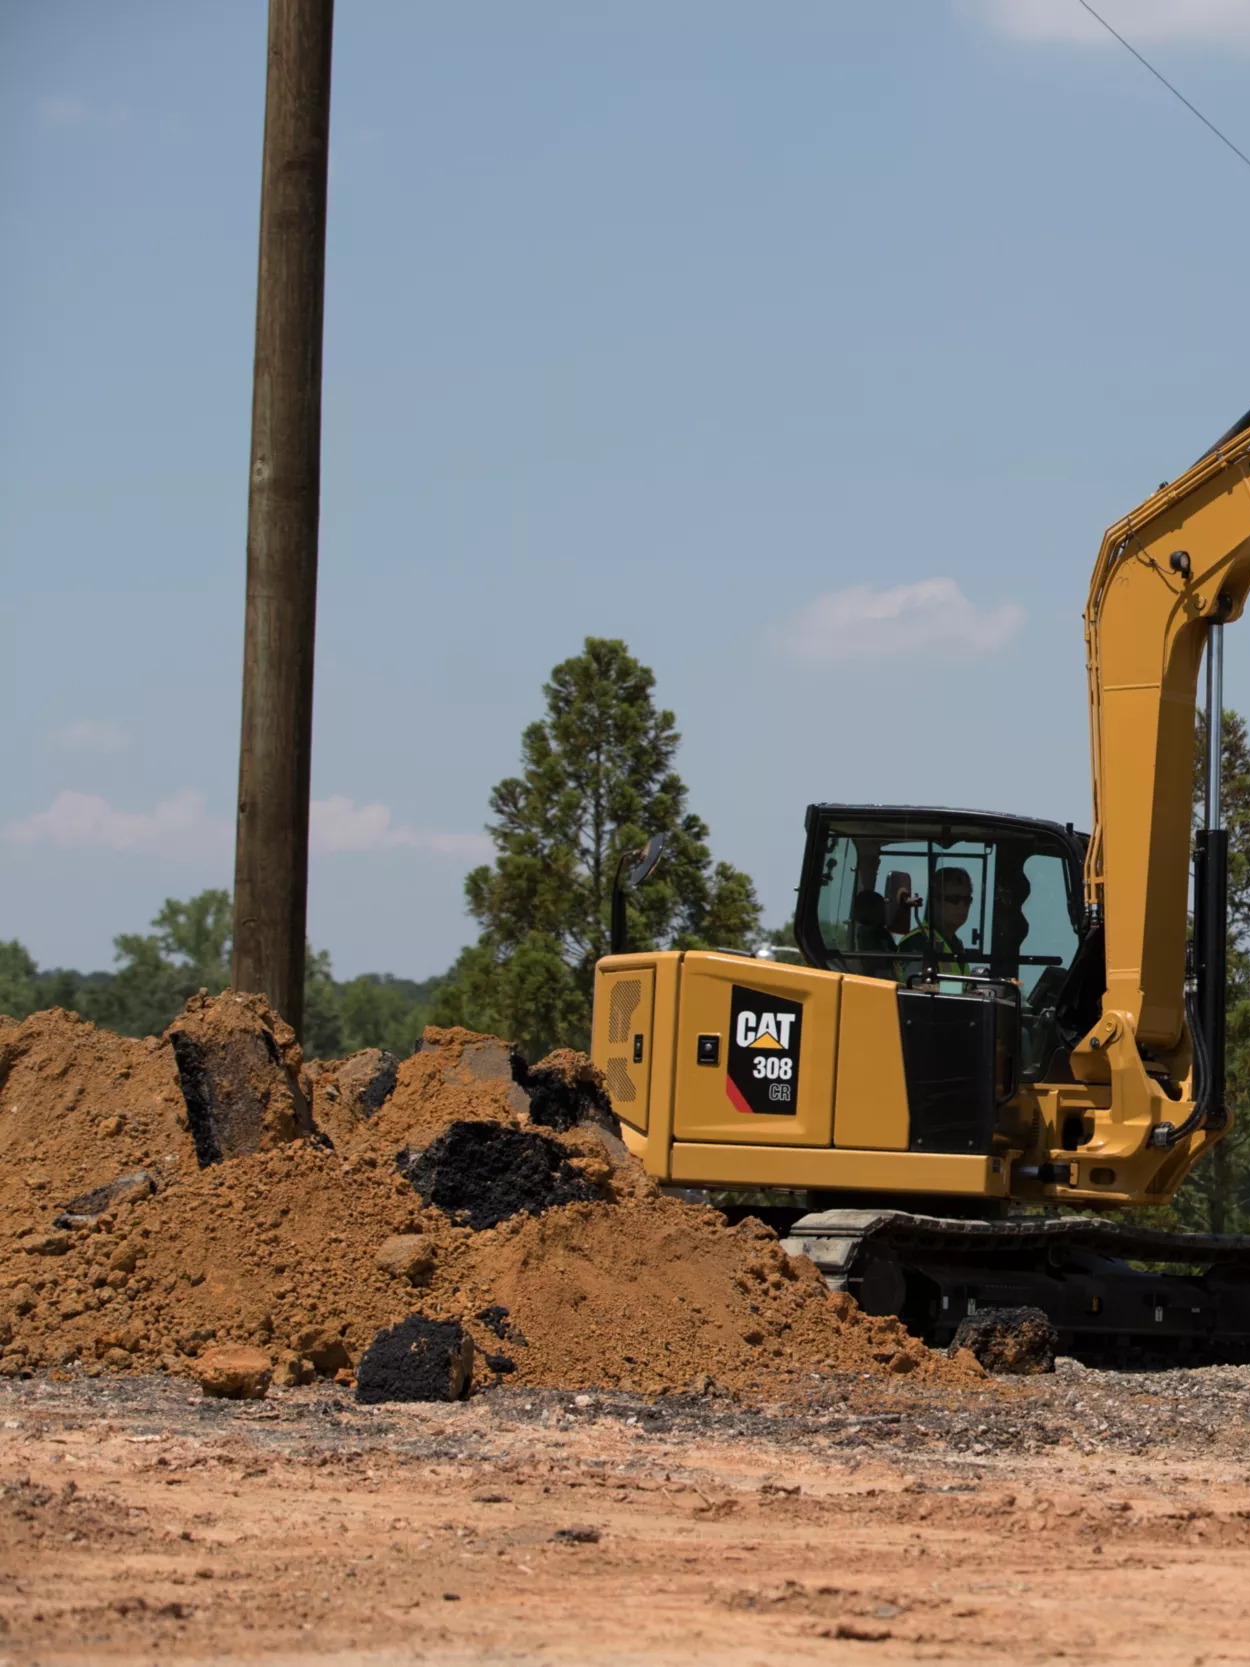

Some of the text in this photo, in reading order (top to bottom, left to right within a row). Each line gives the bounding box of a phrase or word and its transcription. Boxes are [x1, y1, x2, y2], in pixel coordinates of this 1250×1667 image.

[736, 1010, 796, 1050] CAT
[752, 1056, 793, 1080] 308
[768, 1083, 791, 1101] CR
